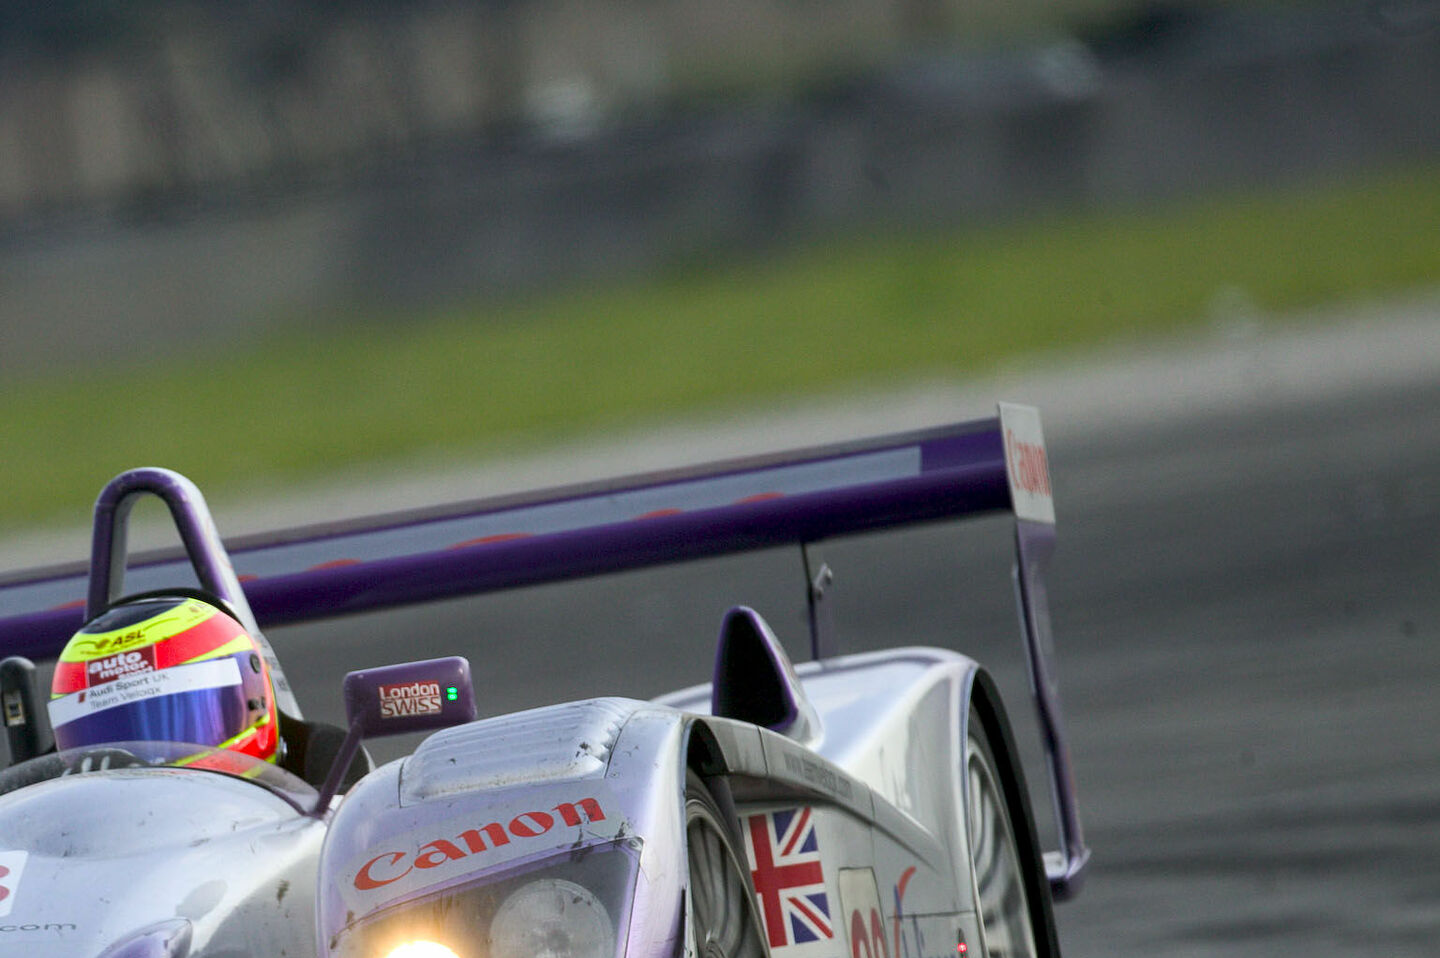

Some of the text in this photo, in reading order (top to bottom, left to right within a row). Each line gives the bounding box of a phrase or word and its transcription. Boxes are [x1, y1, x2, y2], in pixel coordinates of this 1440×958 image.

[111, 630, 146, 648] ASL
[89, 652, 142, 674] auto
[100, 660, 148, 679] motor
[90, 685, 114, 698] Audi
[115, 677, 149, 691] Sport
[379, 682, 440, 700] London
[90, 697, 119, 709] Team
[381, 698, 442, 717] SWISS
[353, 797, 606, 890] Canon
